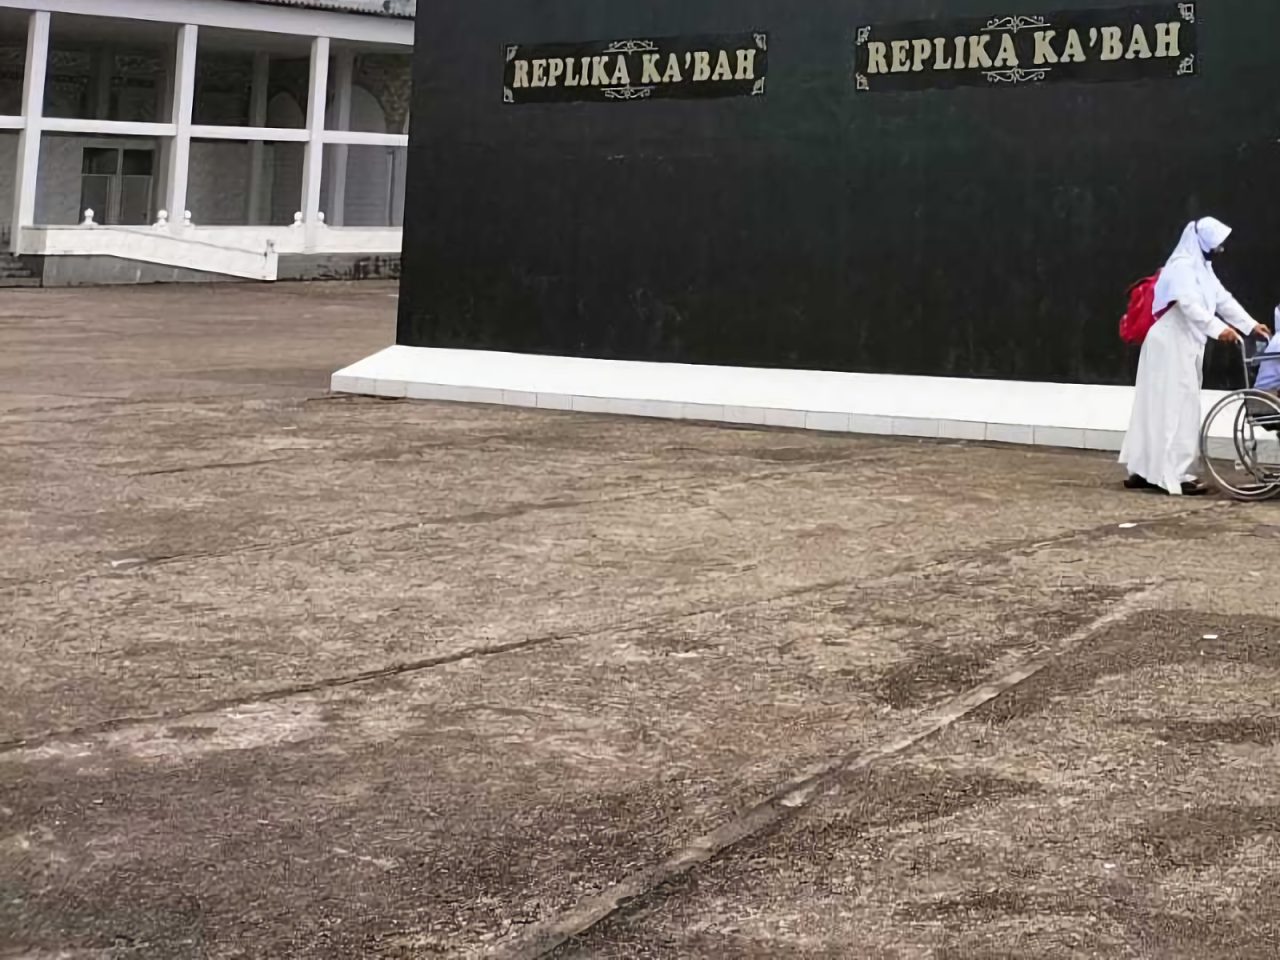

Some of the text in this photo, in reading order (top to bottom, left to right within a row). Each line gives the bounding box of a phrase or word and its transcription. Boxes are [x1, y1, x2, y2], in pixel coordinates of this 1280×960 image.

[513, 48, 756, 88] REPLIKA KA'BAH
[867, 22, 1181, 74] REPLIKA KA'BAH
